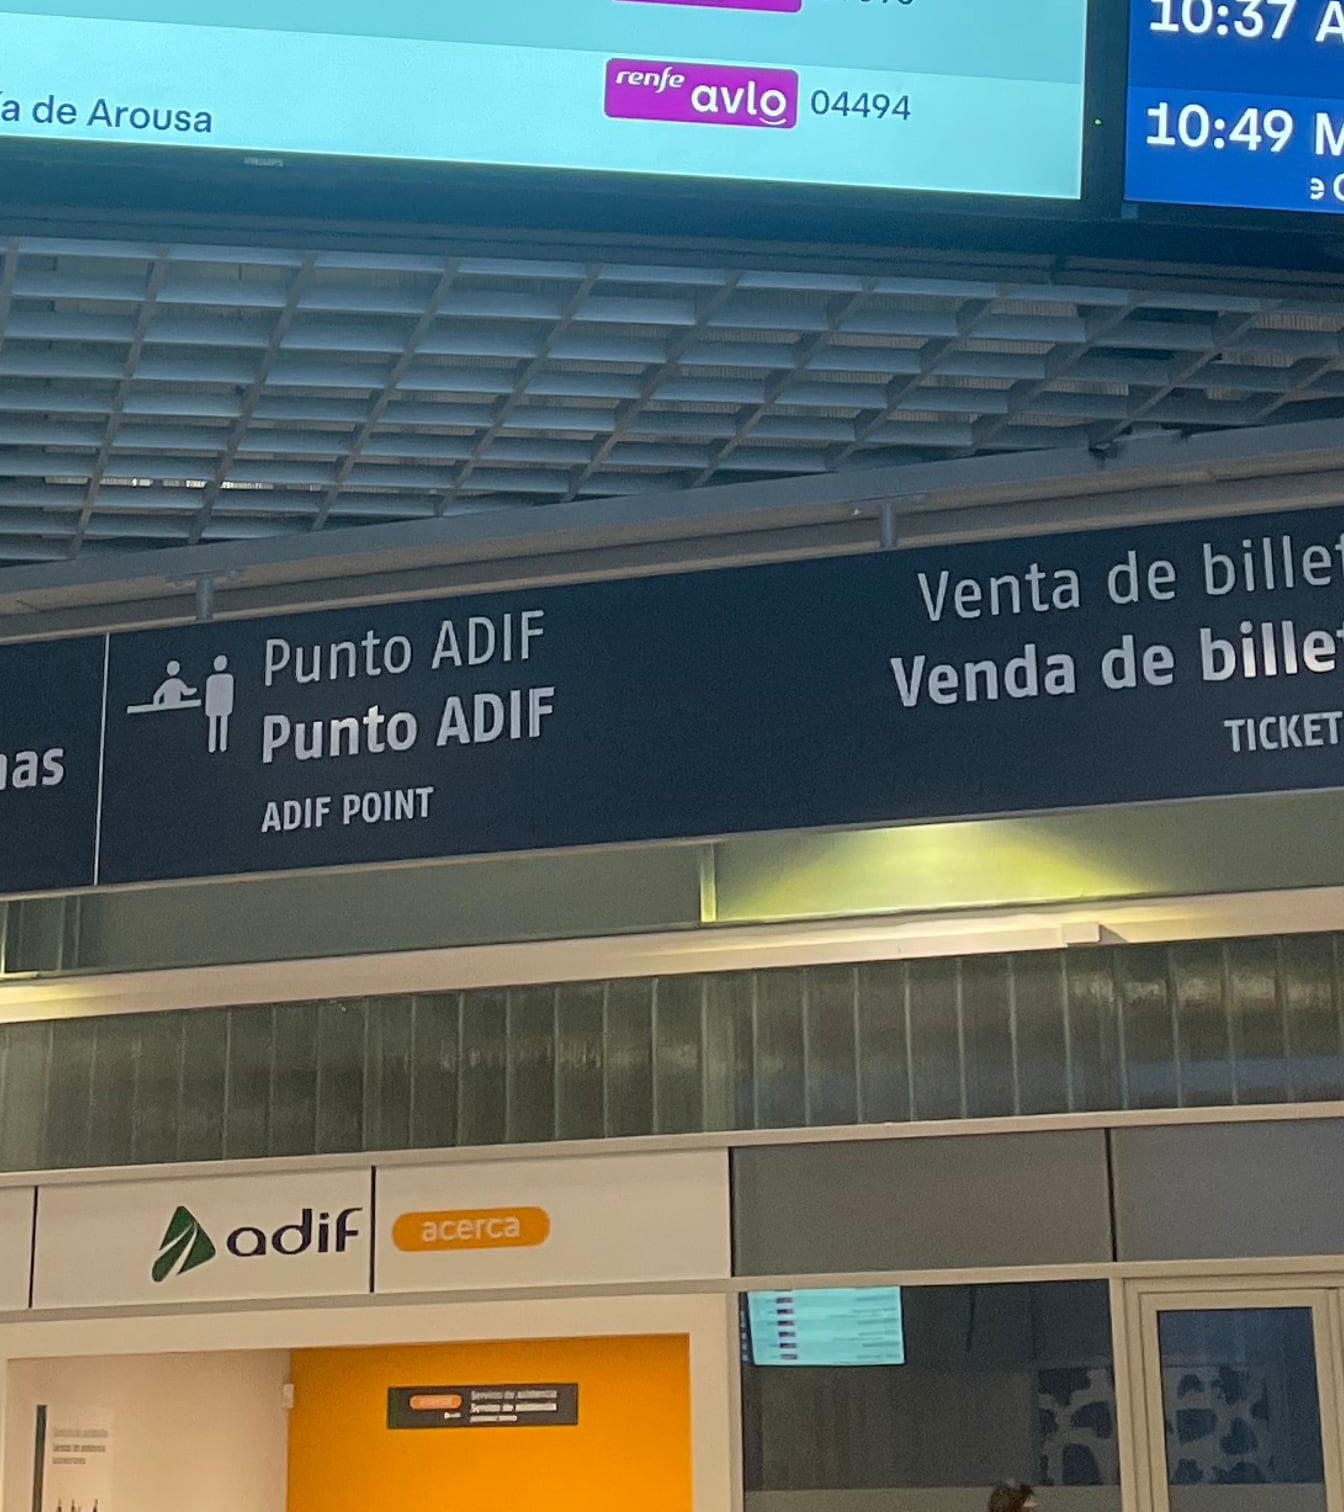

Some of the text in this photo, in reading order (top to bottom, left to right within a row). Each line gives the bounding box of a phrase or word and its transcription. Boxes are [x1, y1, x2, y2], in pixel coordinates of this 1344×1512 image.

[32, 94, 77, 125] de
[86, 98, 212, 133] Arousa
[690, 80, 787, 126] avlo
[810, 89, 911, 121] 04494
[1146, 102, 1293, 153] 10:49
[917, 562, 1080, 622] Venta
[1107, 550, 1176, 604] de
[264, 610, 544, 687] Punto ADIF
[890, 643, 1076, 707] Venda
[1101, 634, 1174, 689] de
[262, 686, 555, 764] Punto ADIF
[1223, 710, 1343, 753] TICKET
[261, 786, 434, 833] ADIF POINT
[226, 1207, 363, 1258] adif
[420, 1216, 521, 1242] acerca
